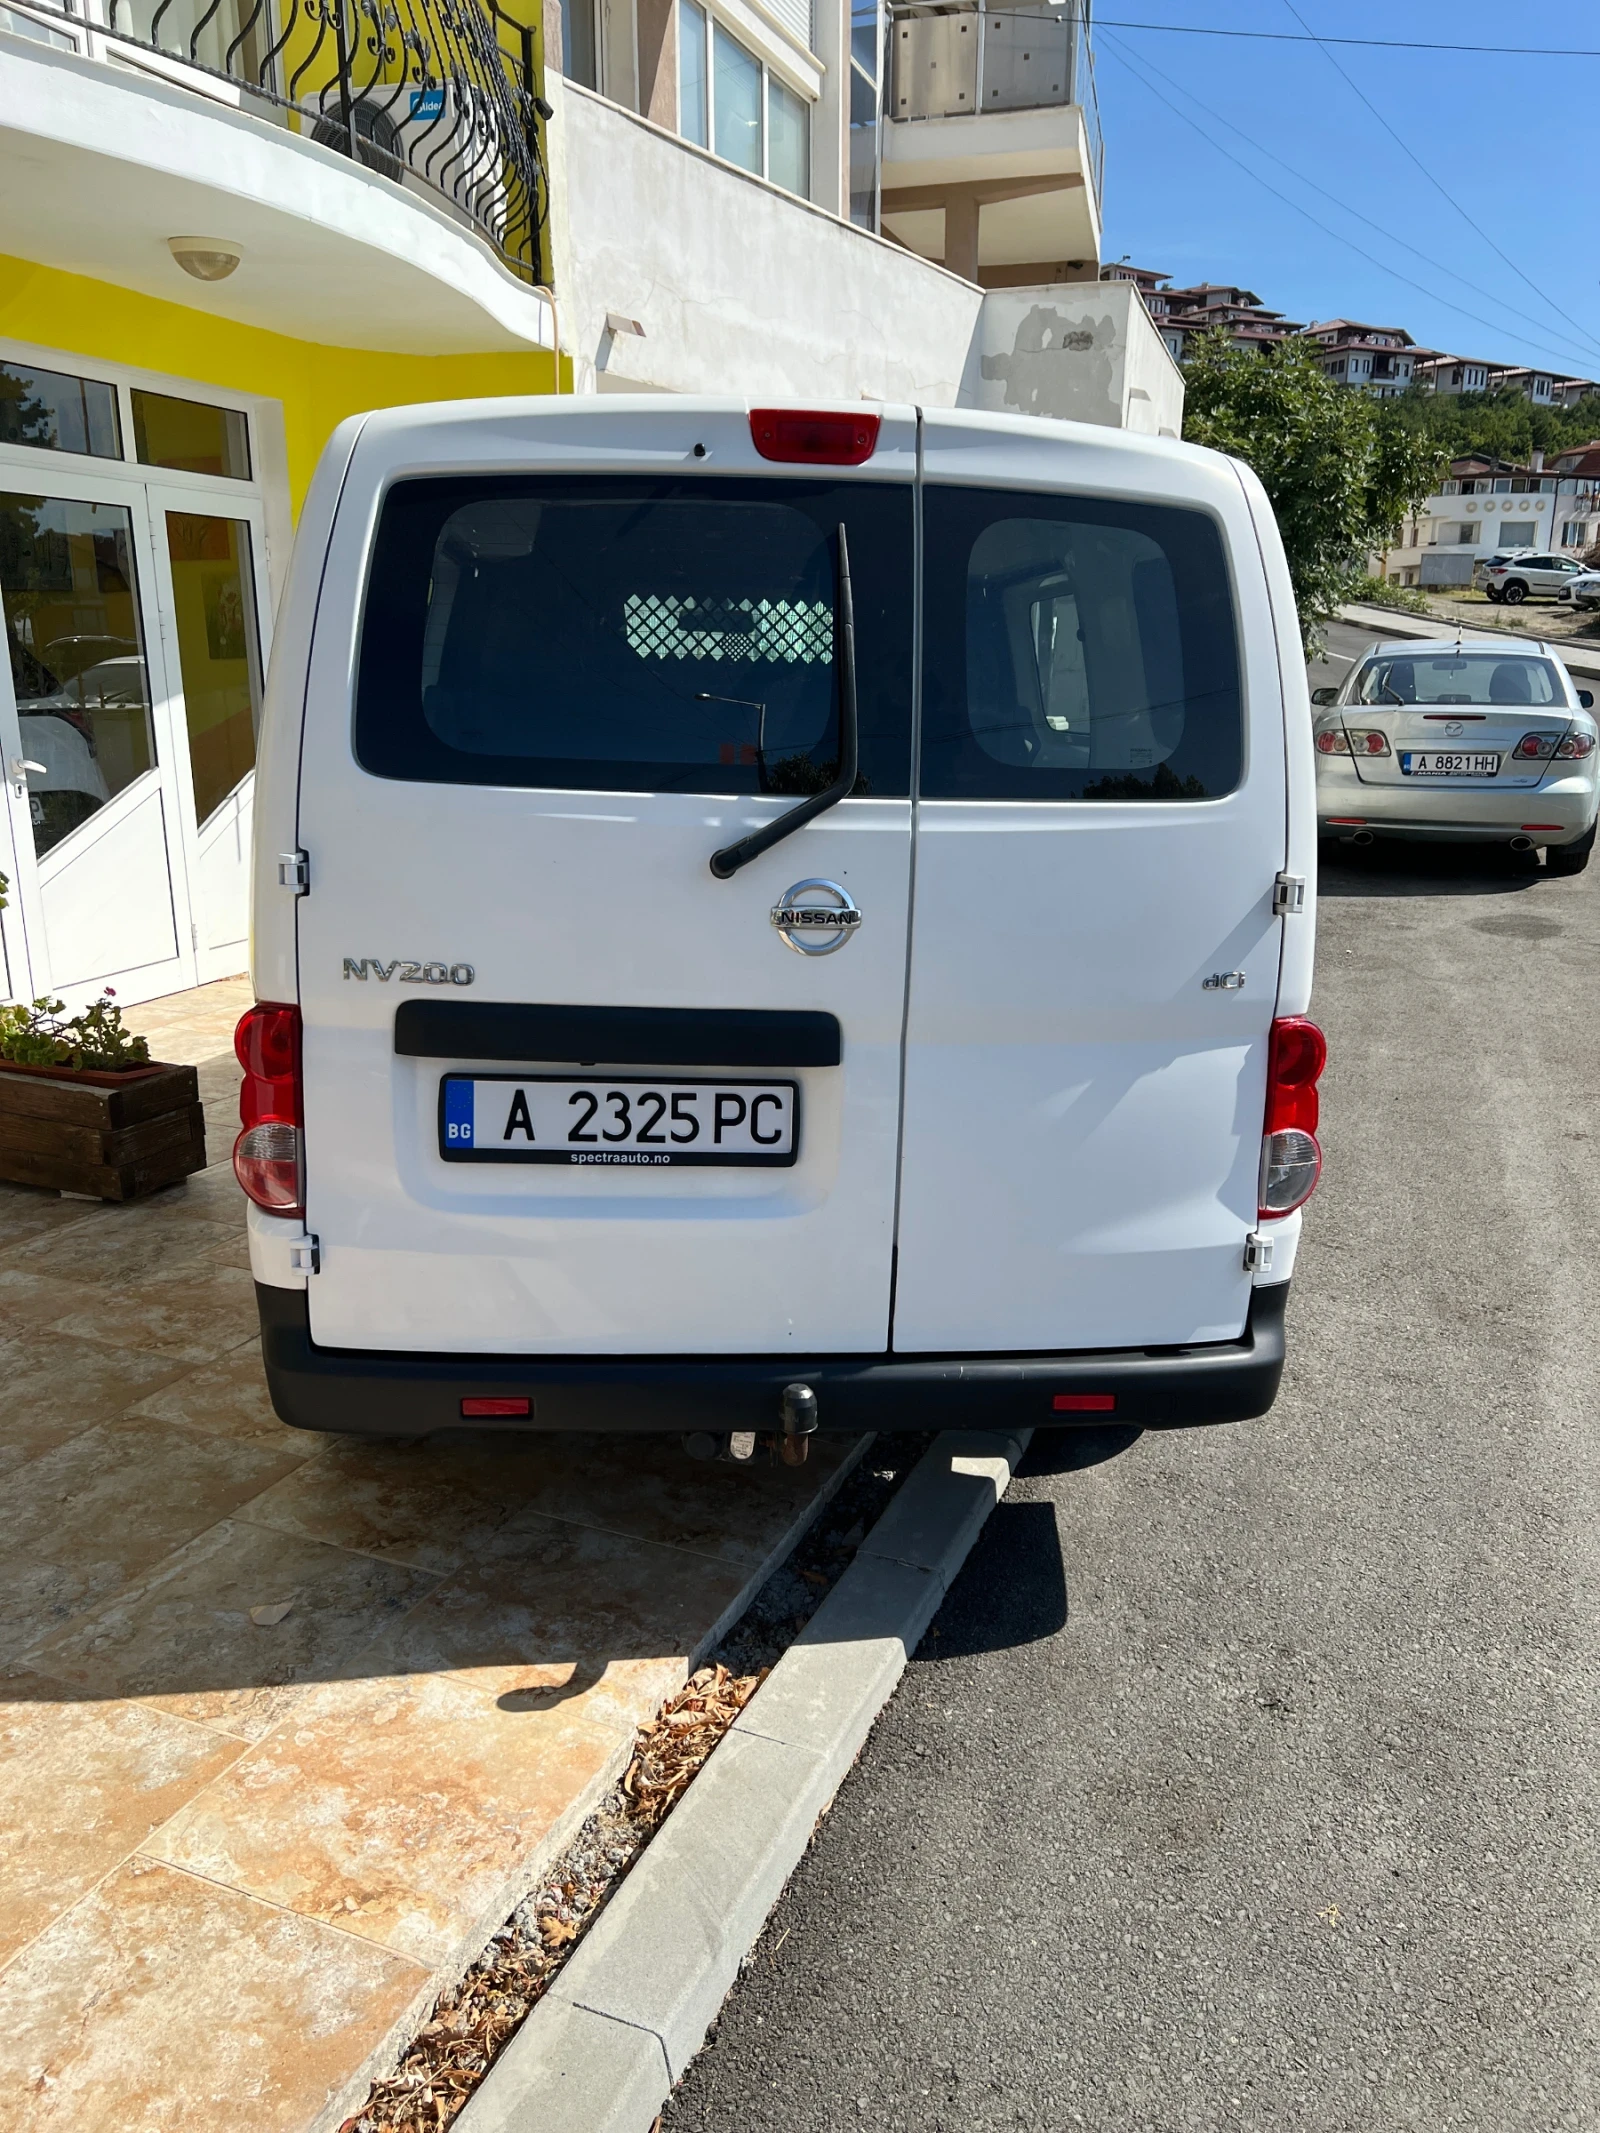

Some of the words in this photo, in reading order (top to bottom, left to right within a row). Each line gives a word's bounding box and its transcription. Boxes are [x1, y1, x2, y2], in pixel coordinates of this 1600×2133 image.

[1418, 756, 1427, 769] A
[1435, 756, 1470, 770] 8821
[1475, 756, 1495, 770] HH
[781, 911, 852, 924] NISSAN
[343, 957, 475, 987] NV200
[1202, 971, 1246, 990] dCi
[503, 1089, 535, 1141] A
[567, 1090, 700, 1144] 2325
[714, 1093, 783, 1145] PC
[448, 1123, 471, 1139] BG
[570, 1152, 671, 1165] spectraauto.no
